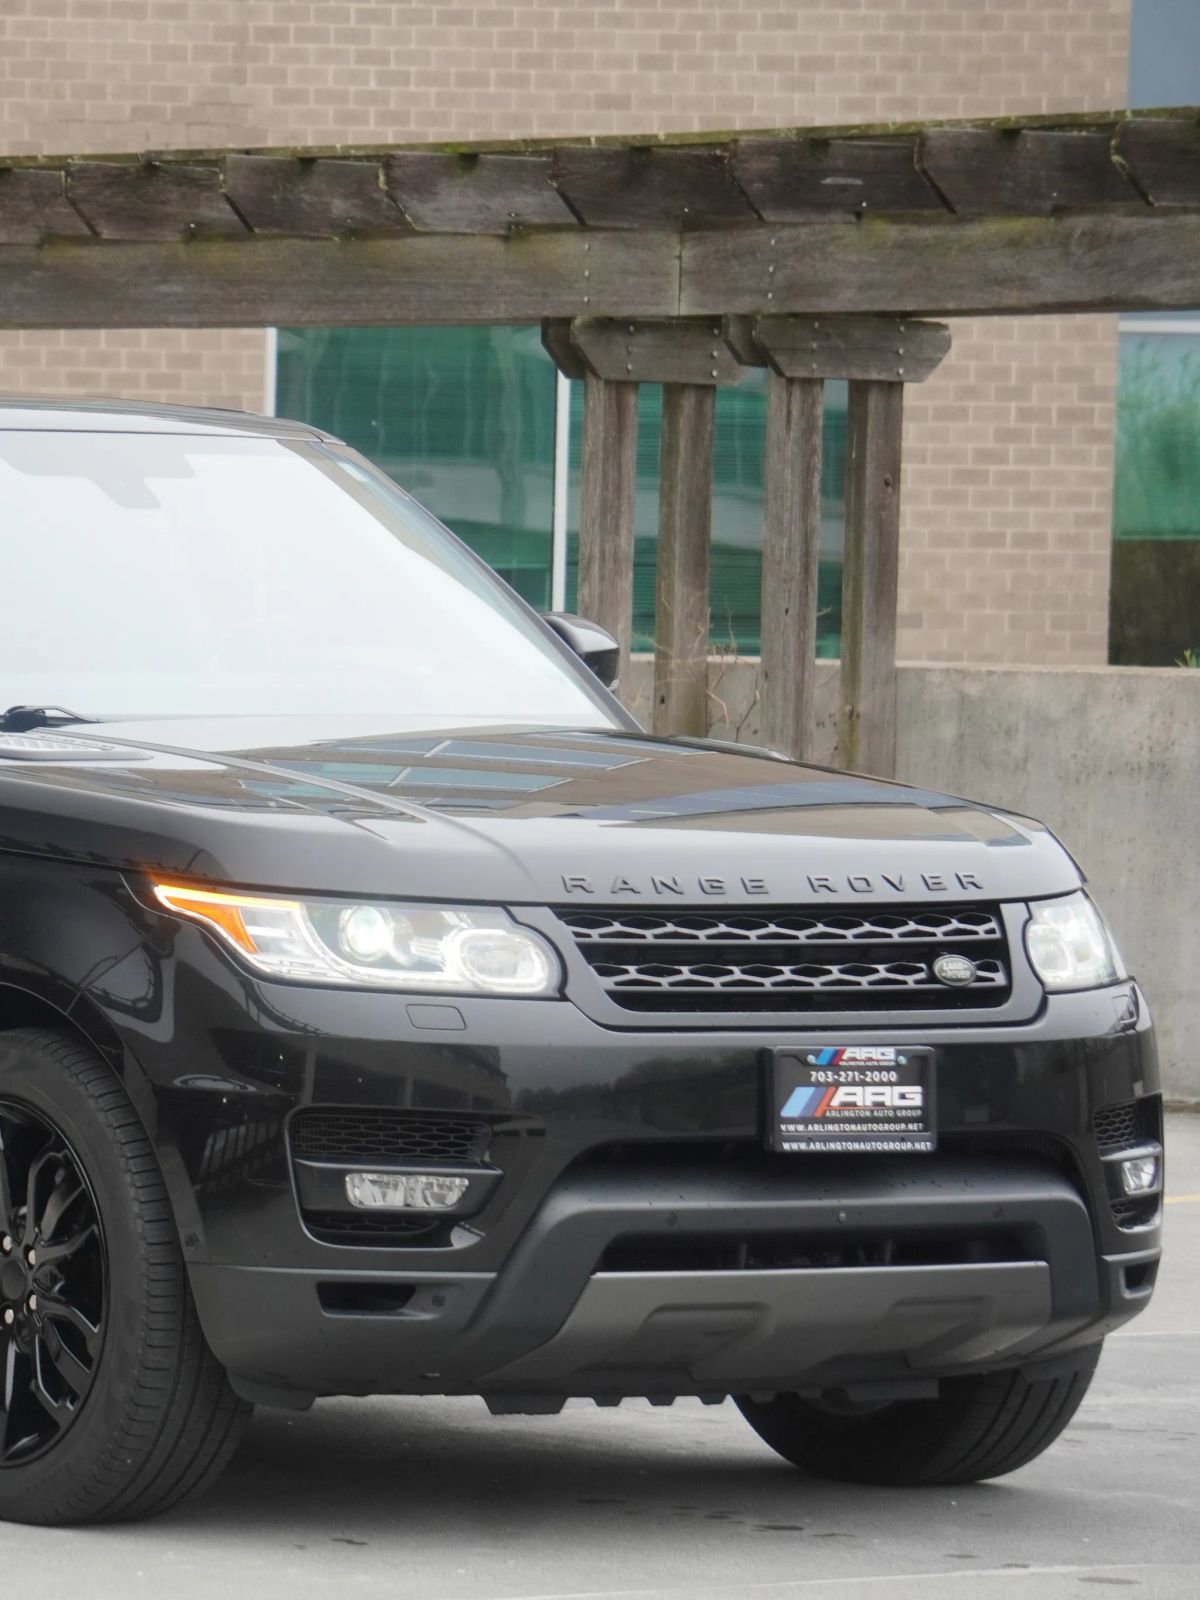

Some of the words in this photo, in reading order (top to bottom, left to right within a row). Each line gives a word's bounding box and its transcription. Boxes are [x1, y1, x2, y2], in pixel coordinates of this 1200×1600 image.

[561, 874, 769, 895] RANGE
[806, 871, 984, 894] ROVER
[841, 1048, 896, 1060] AAG
[810, 1071, 897, 1082] 703-271-2000
[829, 1086, 923, 1107] AAG
[825, 1109, 871, 1118] ARLINGTON
[873, 1109, 894, 1117] AUTO
[896, 1109, 922, 1117] GROUP
[780, 1123, 923, 1132] WWW.ARLINGTONAUTOGROUP.NET
[782, 1142, 932, 1151] WWW.ARLINGTONAUTOGROUP.NET
